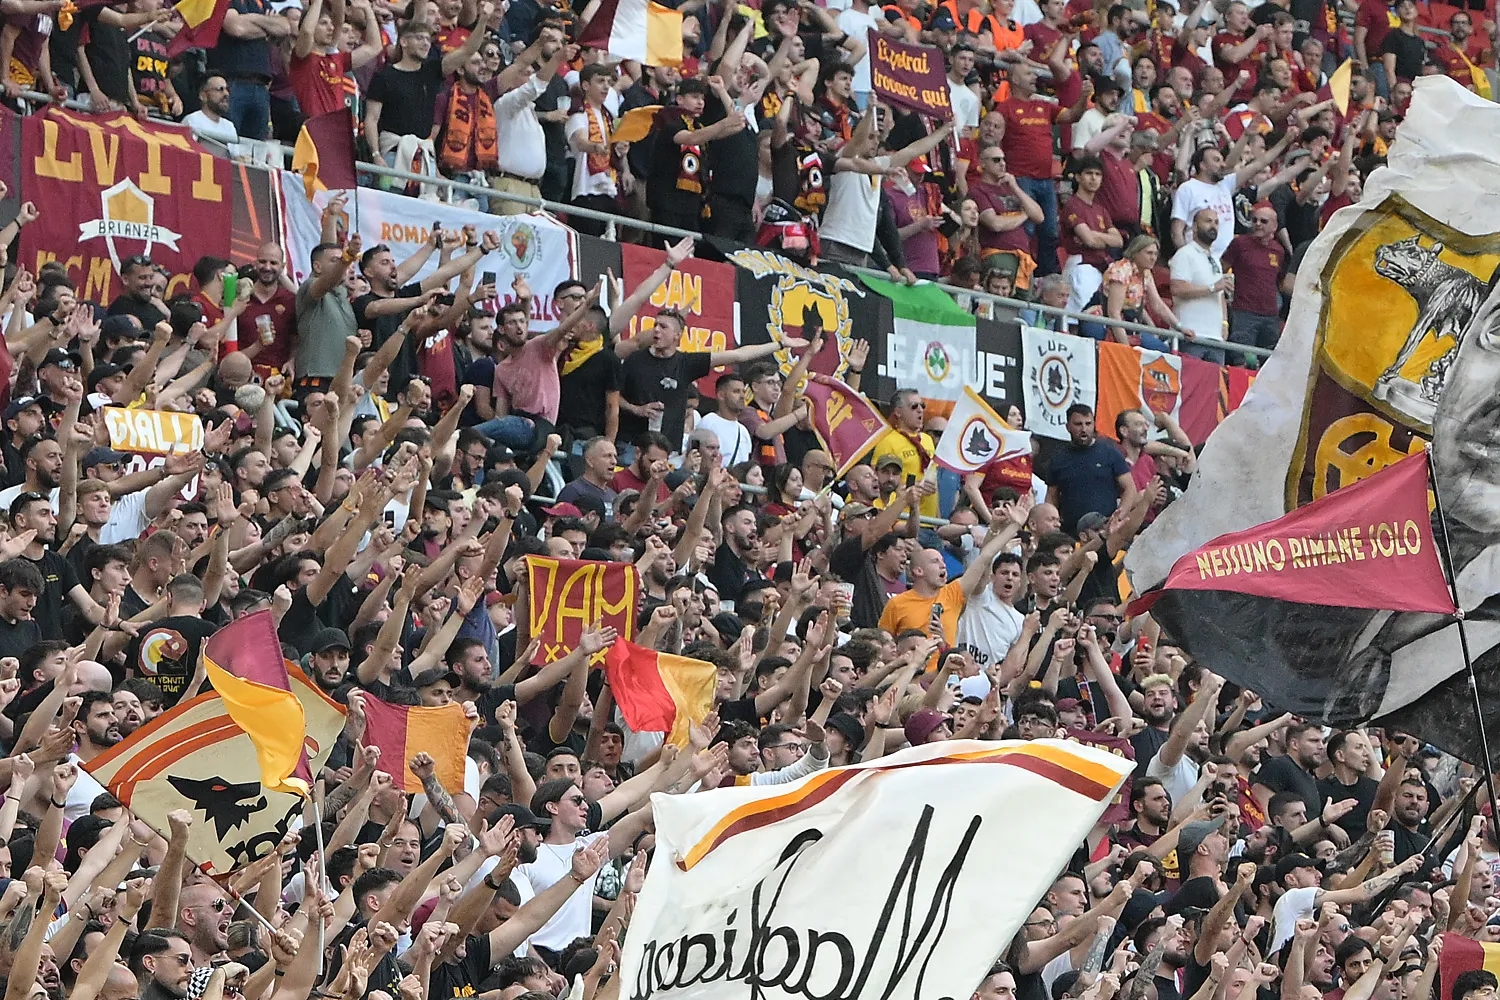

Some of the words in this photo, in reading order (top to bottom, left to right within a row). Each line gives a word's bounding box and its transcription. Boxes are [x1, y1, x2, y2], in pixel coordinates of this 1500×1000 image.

[921, 86, 950, 108] qui
[98, 221, 159, 240] BRIANZA
[650, 270, 702, 316] SAN
[1038, 340, 1074, 362] LUPI
[105, 409, 205, 452] GIALLO
[1196, 538, 1286, 580] NESSUNO
[1288, 526, 1366, 569] RIMANE
[1369, 519, 1422, 559] SOLO
